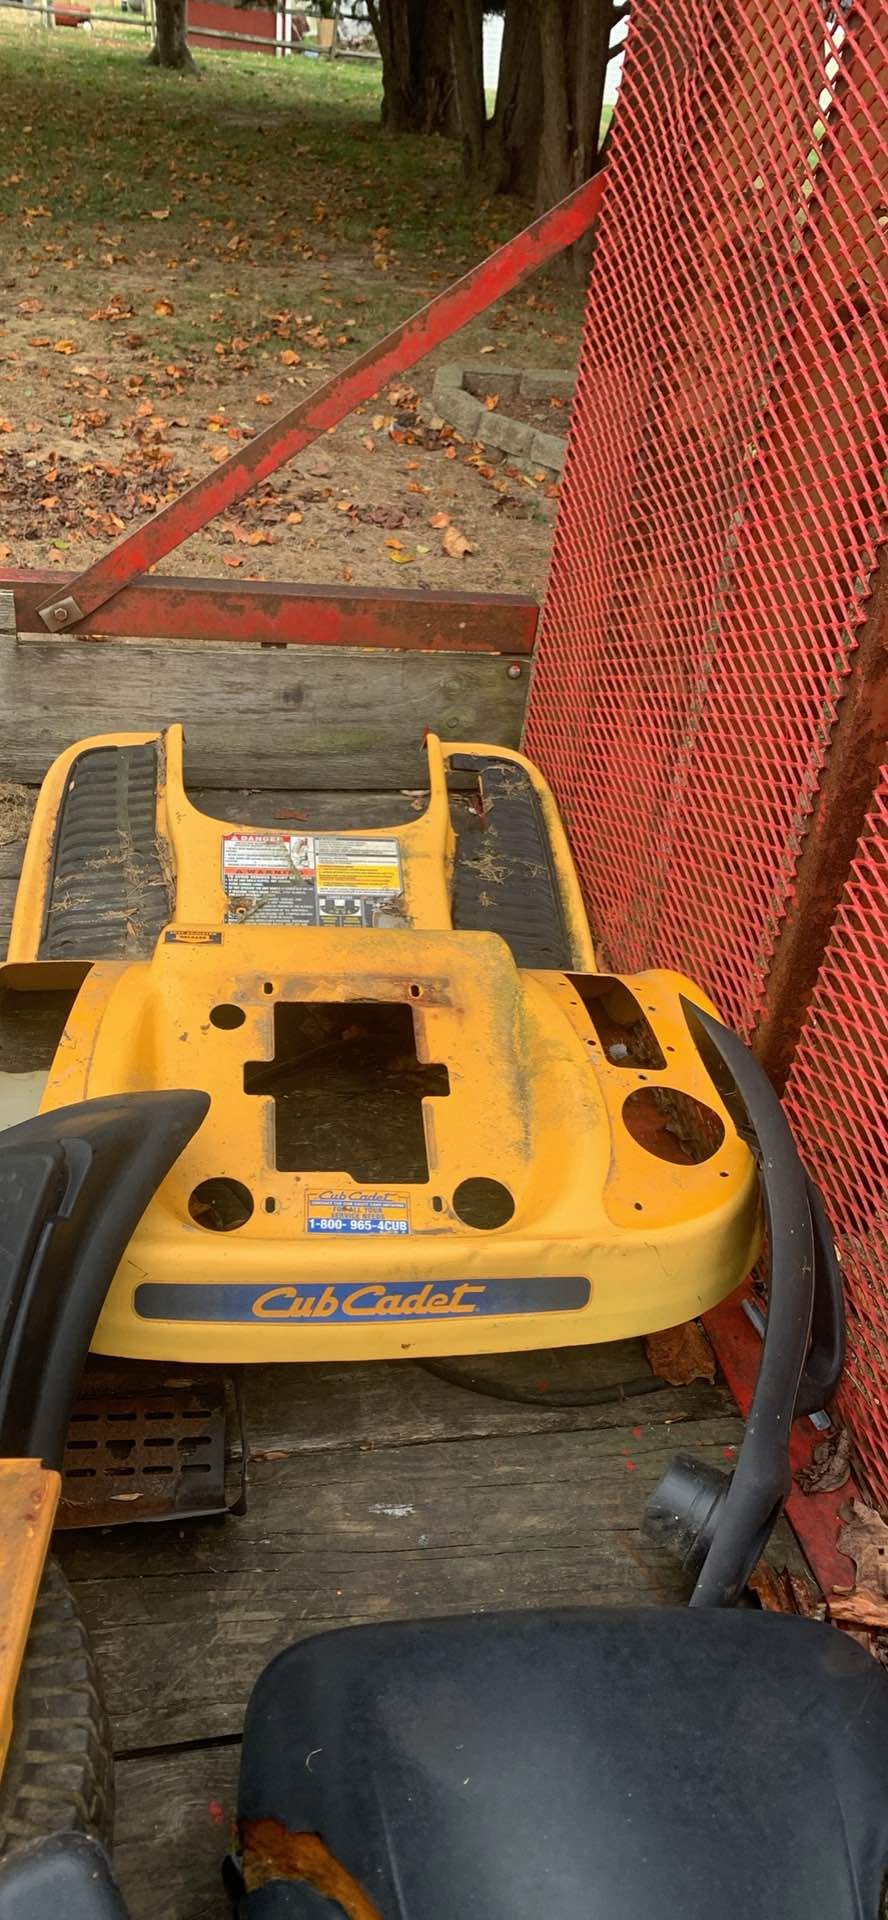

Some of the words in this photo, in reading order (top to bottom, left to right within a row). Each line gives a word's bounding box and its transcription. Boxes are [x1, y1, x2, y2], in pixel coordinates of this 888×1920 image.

[319, 1191, 346, 1200] Cub
[348, 1191, 398, 1201] Cadet
[350, 1220, 407, 1231] 965-4CUB
[252, 1286, 339, 1317] Cub
[342, 1283, 487, 1316] Cadet
